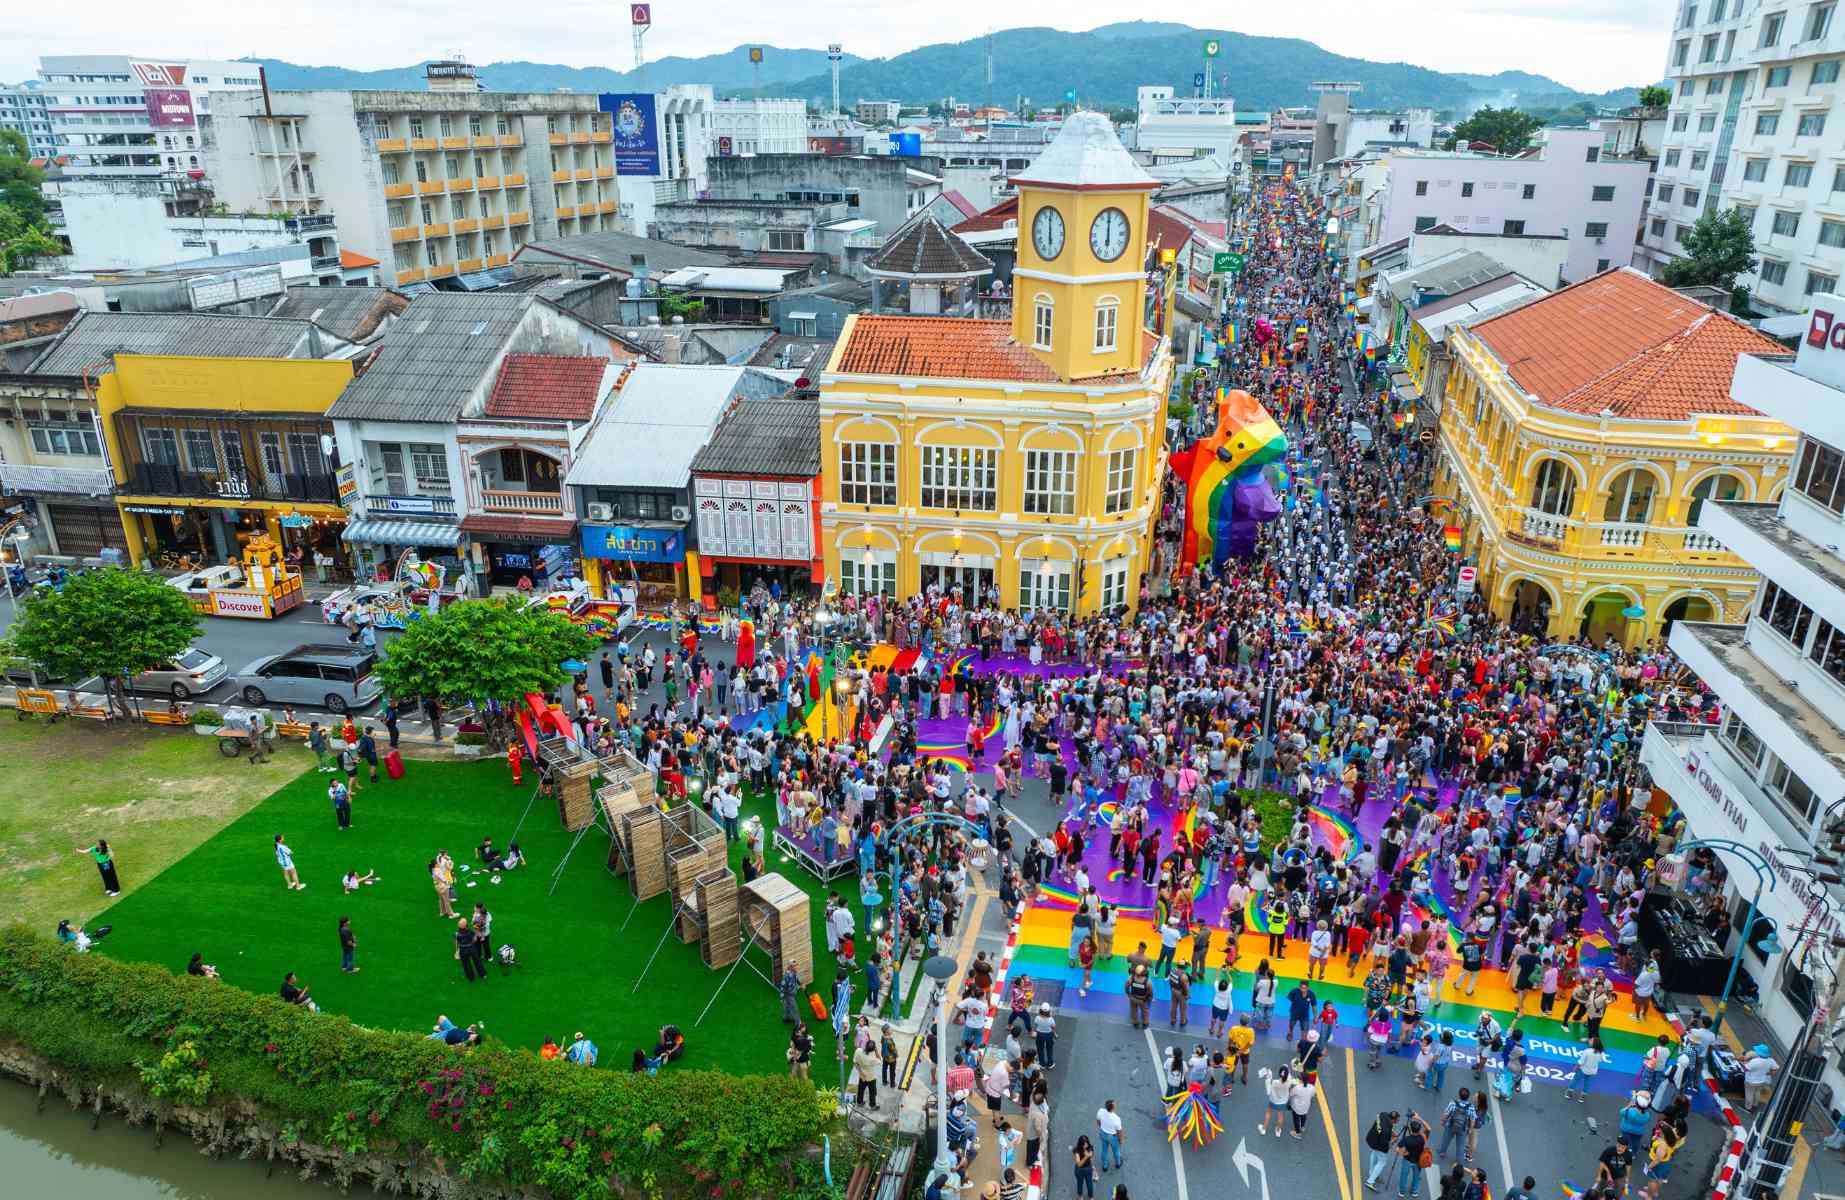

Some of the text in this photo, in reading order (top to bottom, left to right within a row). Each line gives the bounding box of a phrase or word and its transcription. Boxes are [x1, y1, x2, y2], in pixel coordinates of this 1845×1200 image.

[218, 599, 263, 613] Discover
[1723, 797, 1747, 833] THAI
[1529, 1039, 1613, 1064] Phukt
[1525, 1063, 1577, 1081] 2024
